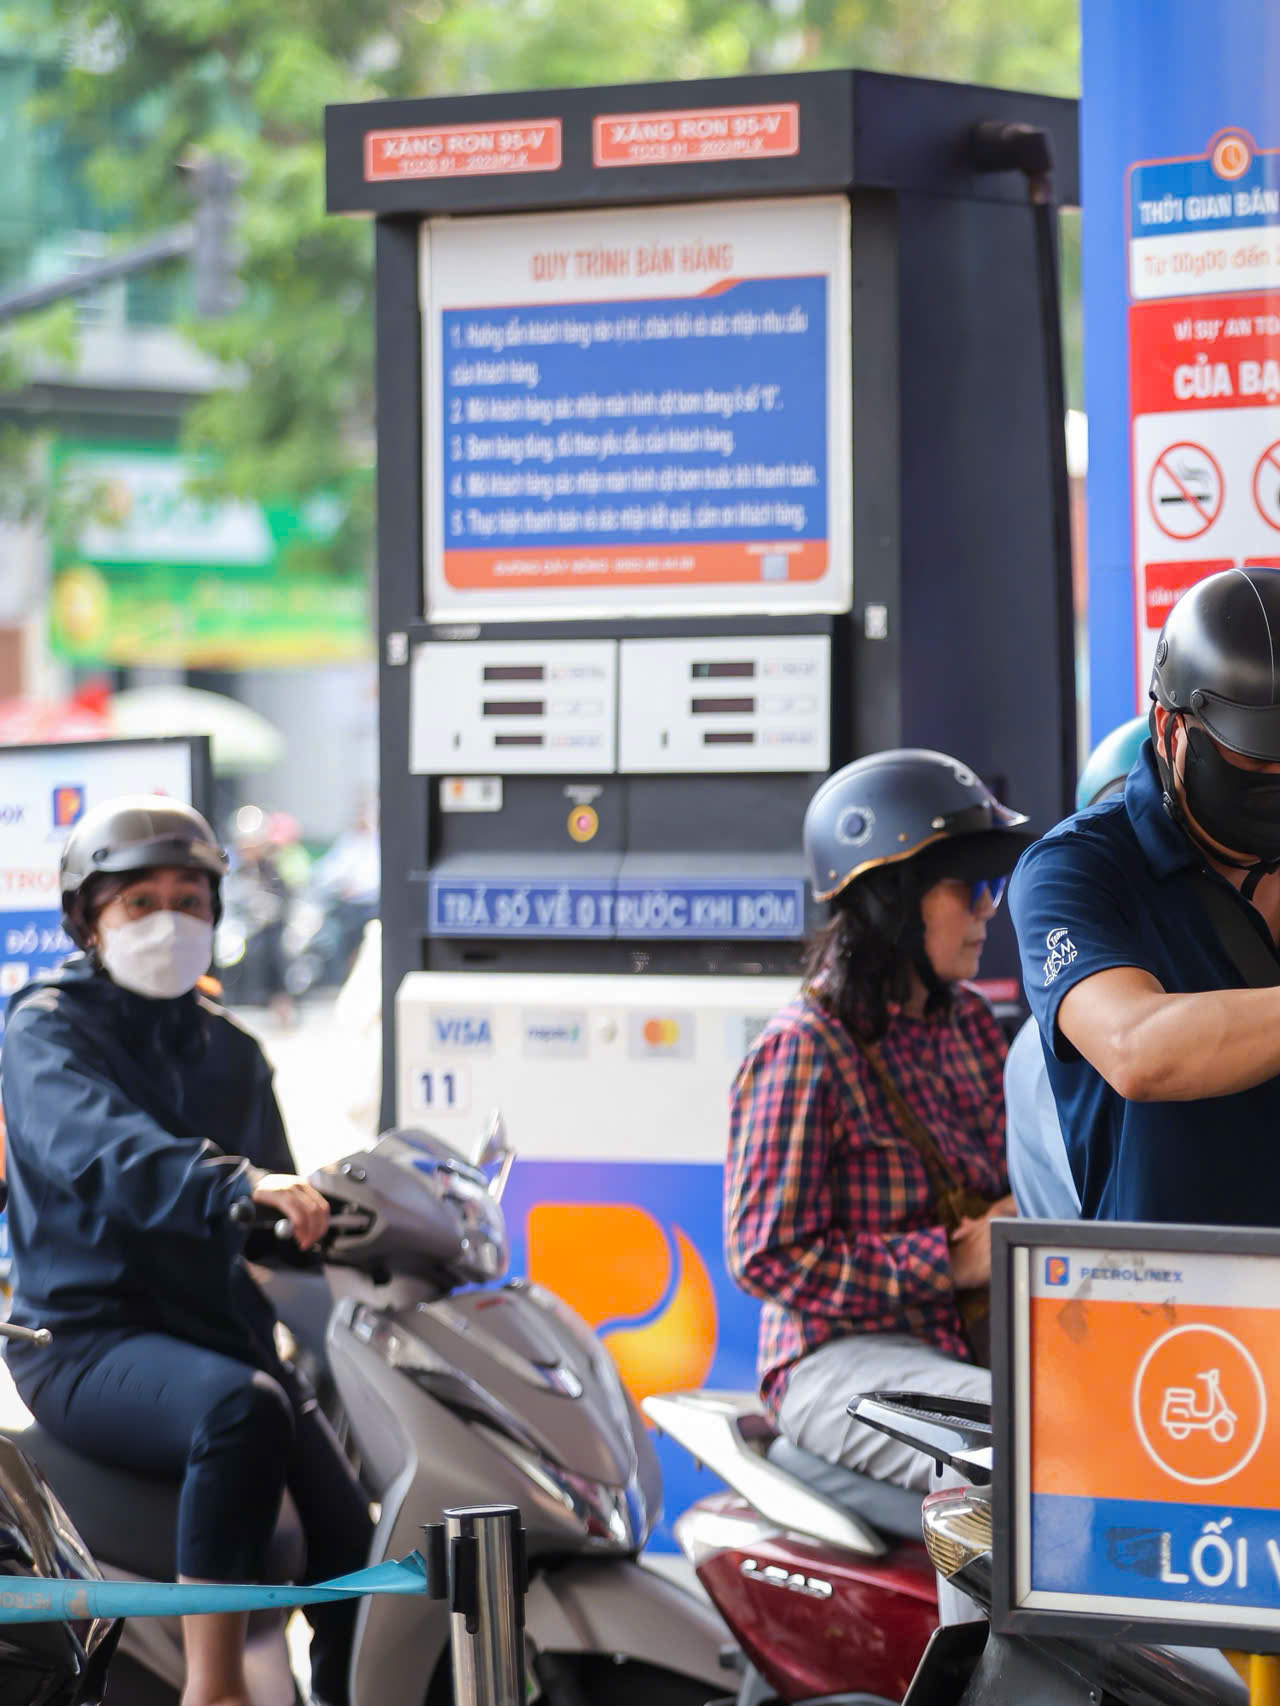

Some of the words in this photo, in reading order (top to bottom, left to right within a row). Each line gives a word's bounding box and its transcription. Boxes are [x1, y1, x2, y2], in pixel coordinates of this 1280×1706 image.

[1186, 194, 1233, 221] GIAN
[531, 252, 569, 283] QUY
[1223, 318, 1252, 338] AN
[1173, 352, 1233, 400] CỦA
[444, 884, 490, 927] TRẢ
[495, 883, 532, 927] SỐ
[535, 884, 573, 927] VỀ
[599, 888, 688, 927] TRƯỚC
[692, 897, 734, 926] KHI
[738, 892, 795, 928] BƠM
[434, 1017, 492, 1045] VISA
[420, 1072, 455, 1106] 11
[1080, 1267, 1184, 1284] PETROLIMEX
[1159, 1517, 1248, 1588] LỐI
